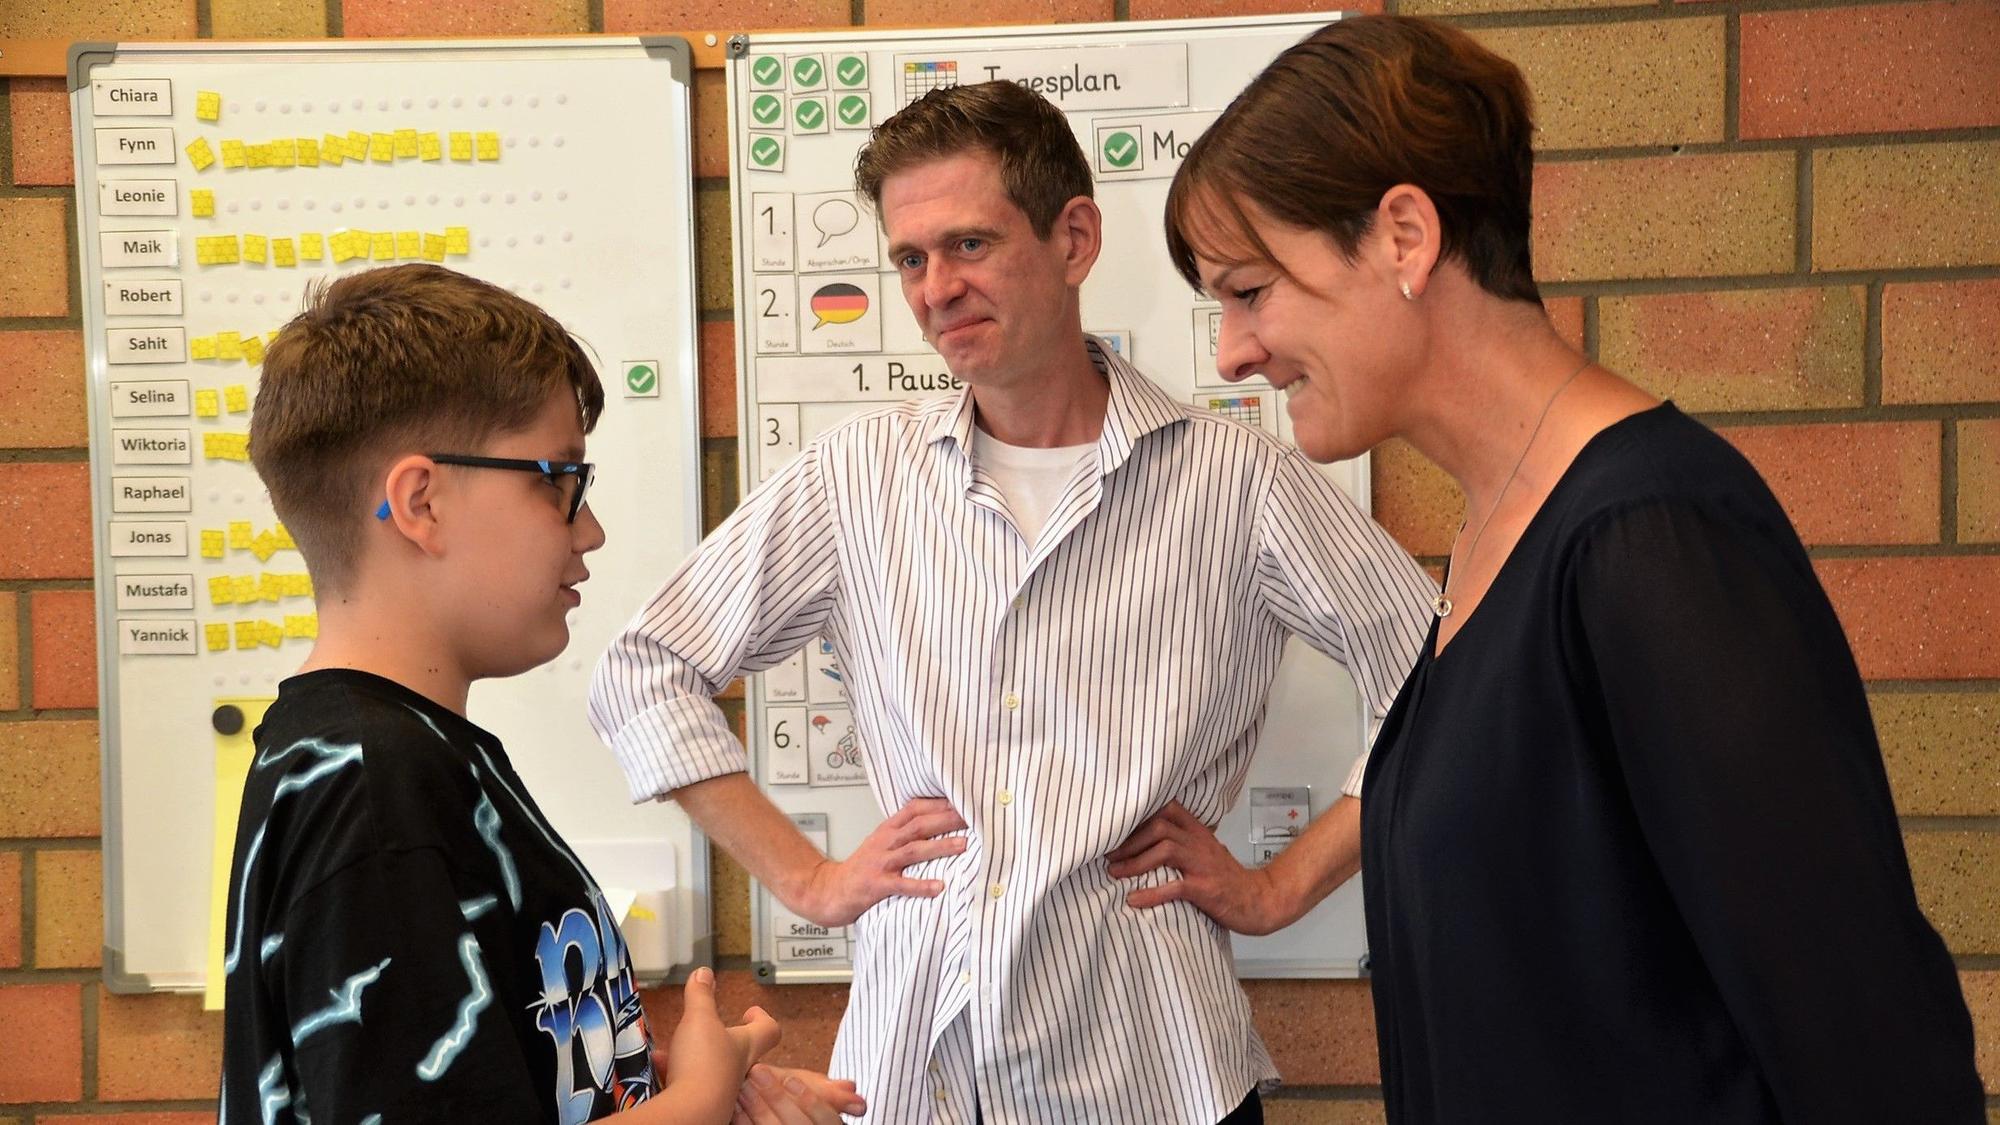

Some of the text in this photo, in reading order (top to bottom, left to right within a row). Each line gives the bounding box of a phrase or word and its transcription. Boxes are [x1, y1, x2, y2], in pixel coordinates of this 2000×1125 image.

[983, 63, 1121, 101] Tesplan
[109, 88, 158, 103] Chiara
[119, 138, 156, 154] Fynn
[1153, 129, 1195, 161] Mo
[115, 189, 165, 202] Leonie
[761, 206, 787, 235] 1.
[123, 240, 162, 253] Maik
[120, 289, 172, 302] Robert
[761, 288, 789, 317] 2.
[129, 336, 168, 350] Sahit
[852, 362, 963, 391] 1. Pause
[130, 391, 175, 403] Selina
[766, 418, 793, 446] 3.
[121, 438, 187, 452] Wiktoria
[124, 486, 185, 501] Raphael
[129, 531, 172, 544] Jonas
[126, 584, 188, 597] Mustafa
[131, 628, 189, 642] Yannick
[774, 720, 801, 749] 6.
[791, 923, 829, 936] Selina
[792, 944, 834, 958] Leonie
